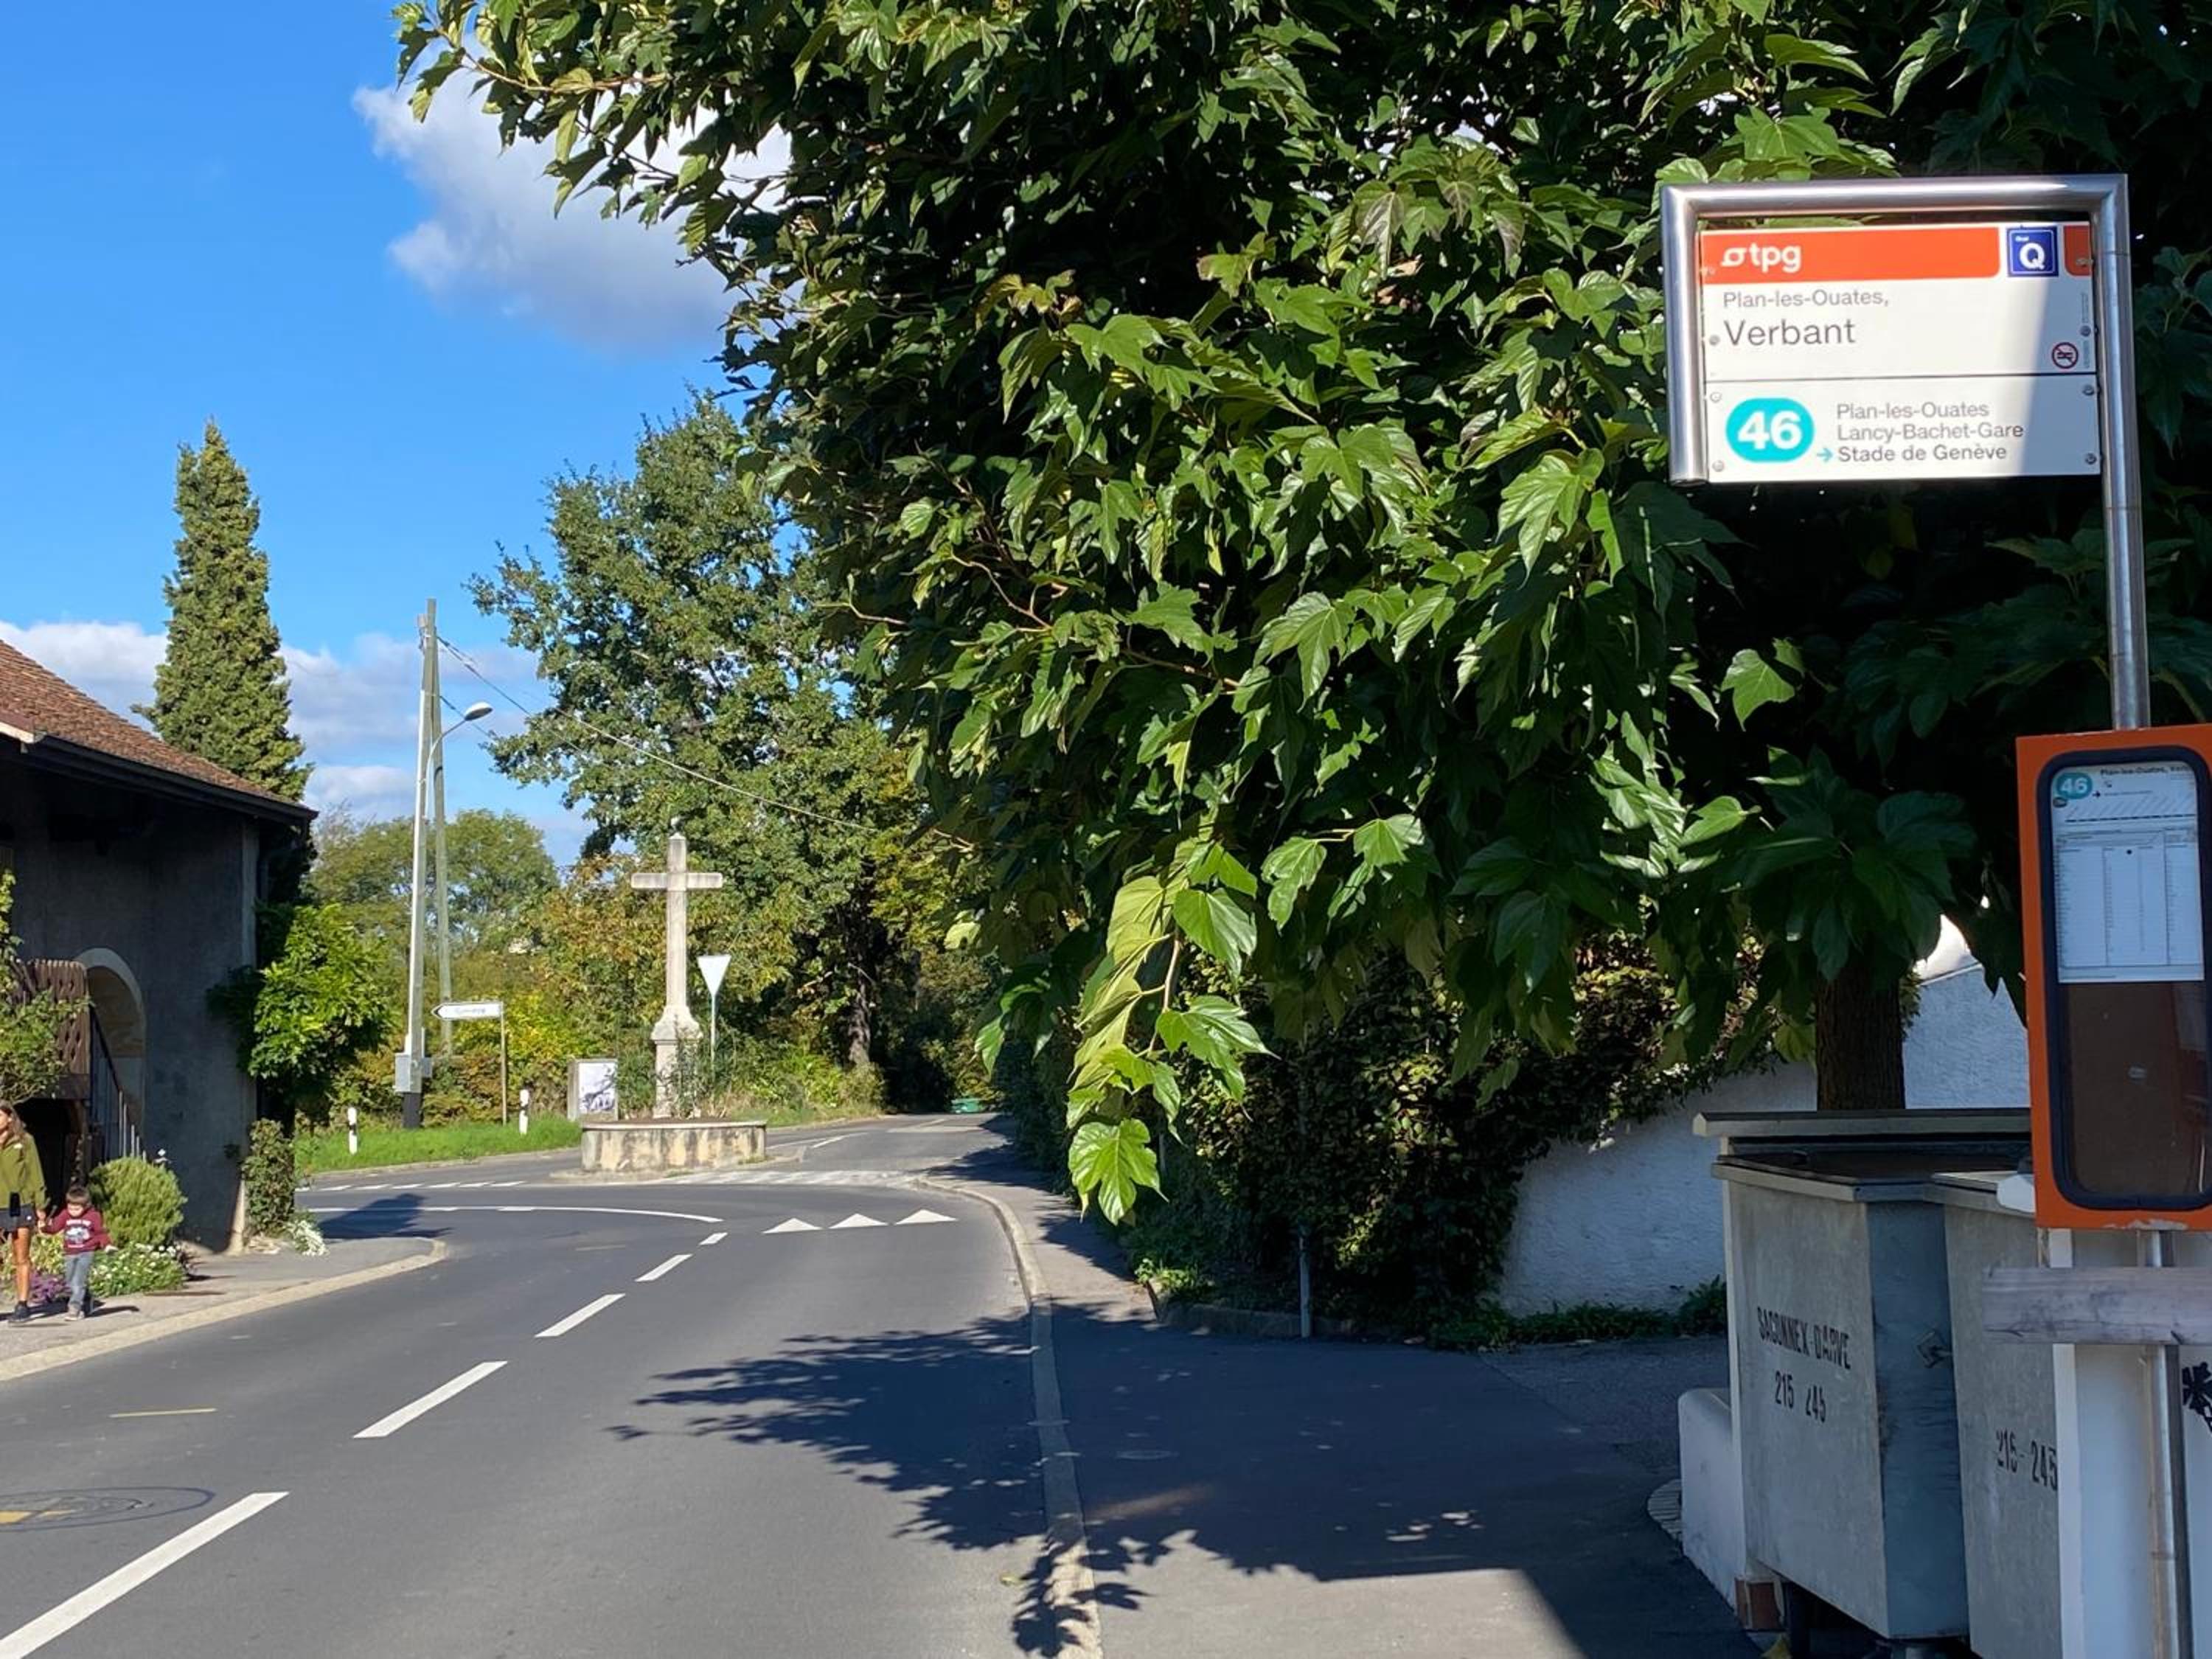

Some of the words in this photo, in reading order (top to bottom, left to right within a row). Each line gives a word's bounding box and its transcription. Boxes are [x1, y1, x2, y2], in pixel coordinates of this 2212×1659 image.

[1748, 242, 1801, 274] tpg
[2020, 243, 2045, 270] Q
[1723, 288, 1888, 307] Plan-les-Ouates,
[1724, 319, 1856, 345] Verbant
[1837, 401, 1989, 420] Plan-les-Ouates
[1737, 411, 1802, 450] 46
[1837, 422, 2024, 443] Lancy-Bachet-Gare
[1837, 445, 1895, 462] Stade
[1902, 444, 1926, 461] de
[1933, 442, 2007, 461] Genève
[2060, 777, 2089, 795] 46
[1775, 1370, 1794, 1409] 215
